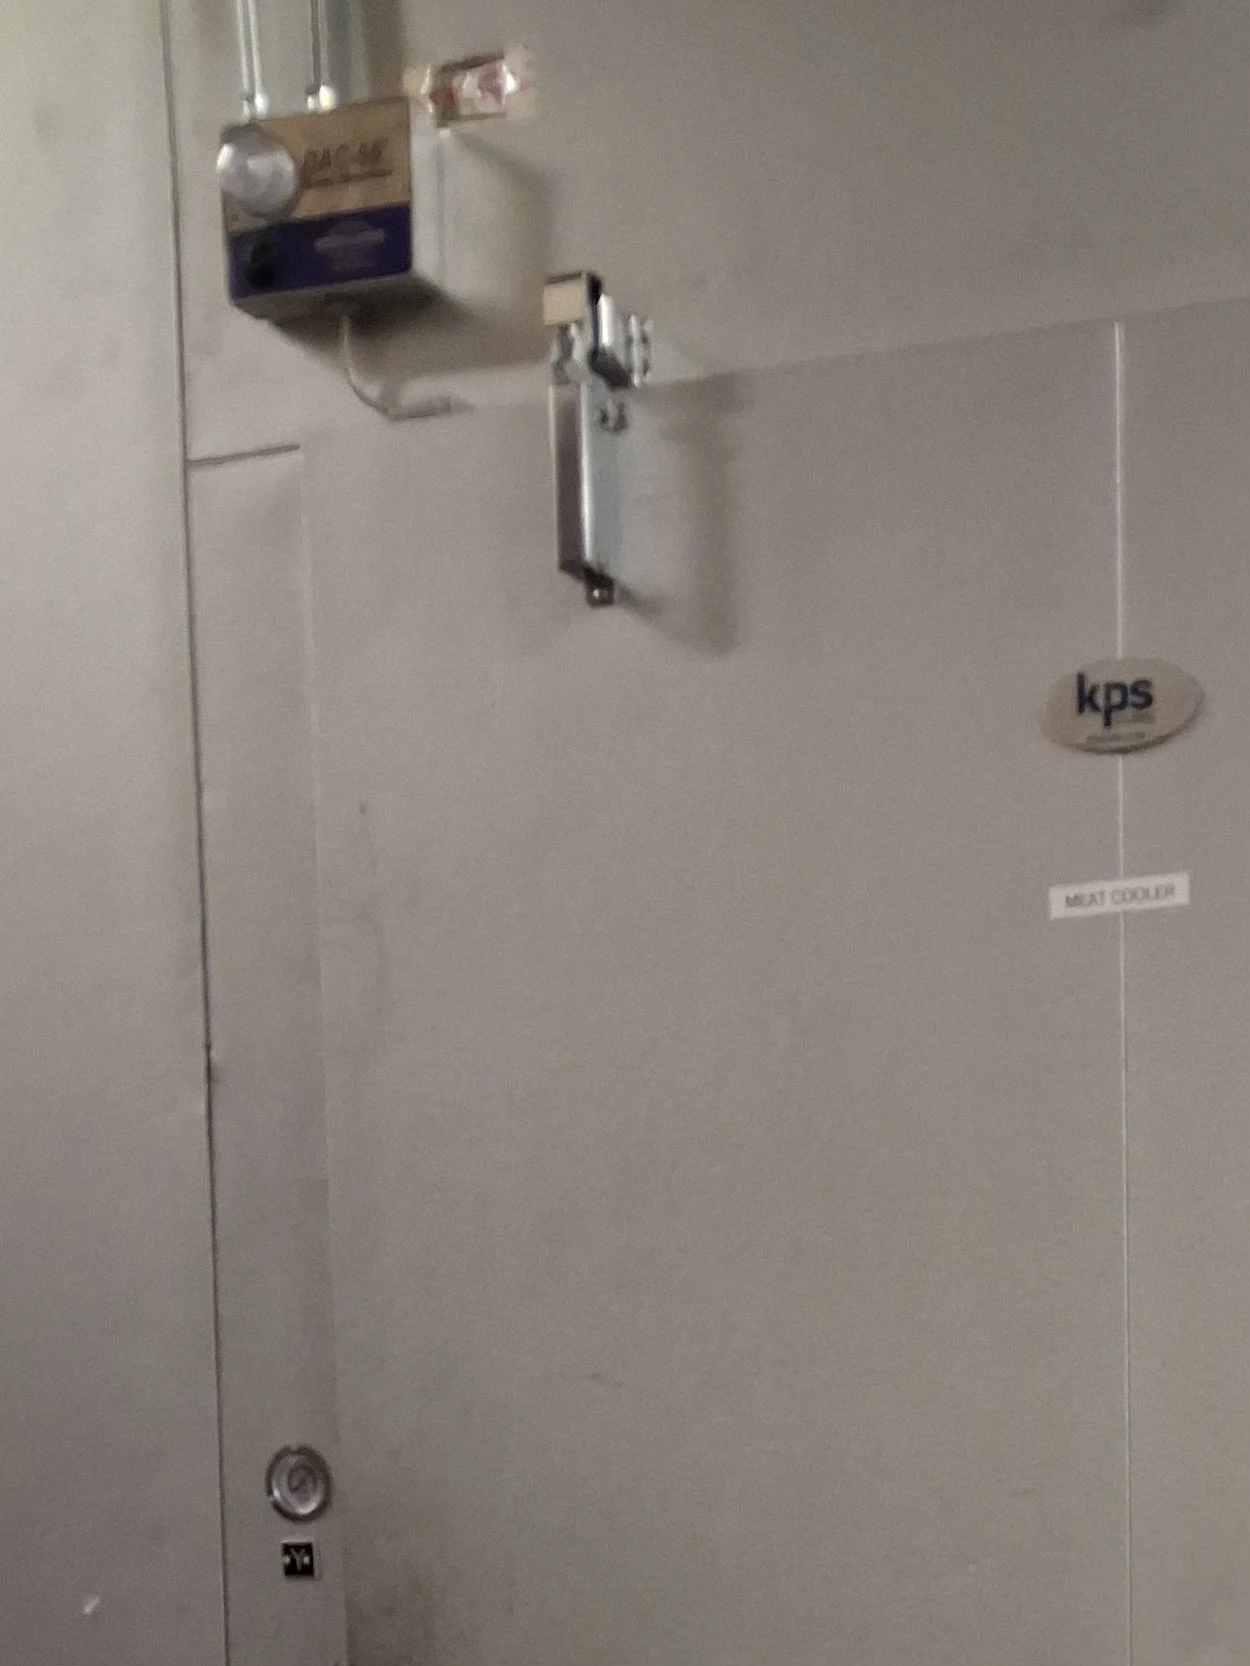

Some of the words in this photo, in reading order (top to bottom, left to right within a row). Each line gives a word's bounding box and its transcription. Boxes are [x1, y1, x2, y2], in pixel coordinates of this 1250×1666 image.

[1076, 672, 1154, 729] kps
[1065, 889, 1106, 908] MEAT
[1110, 882, 1175, 905] COOLER
